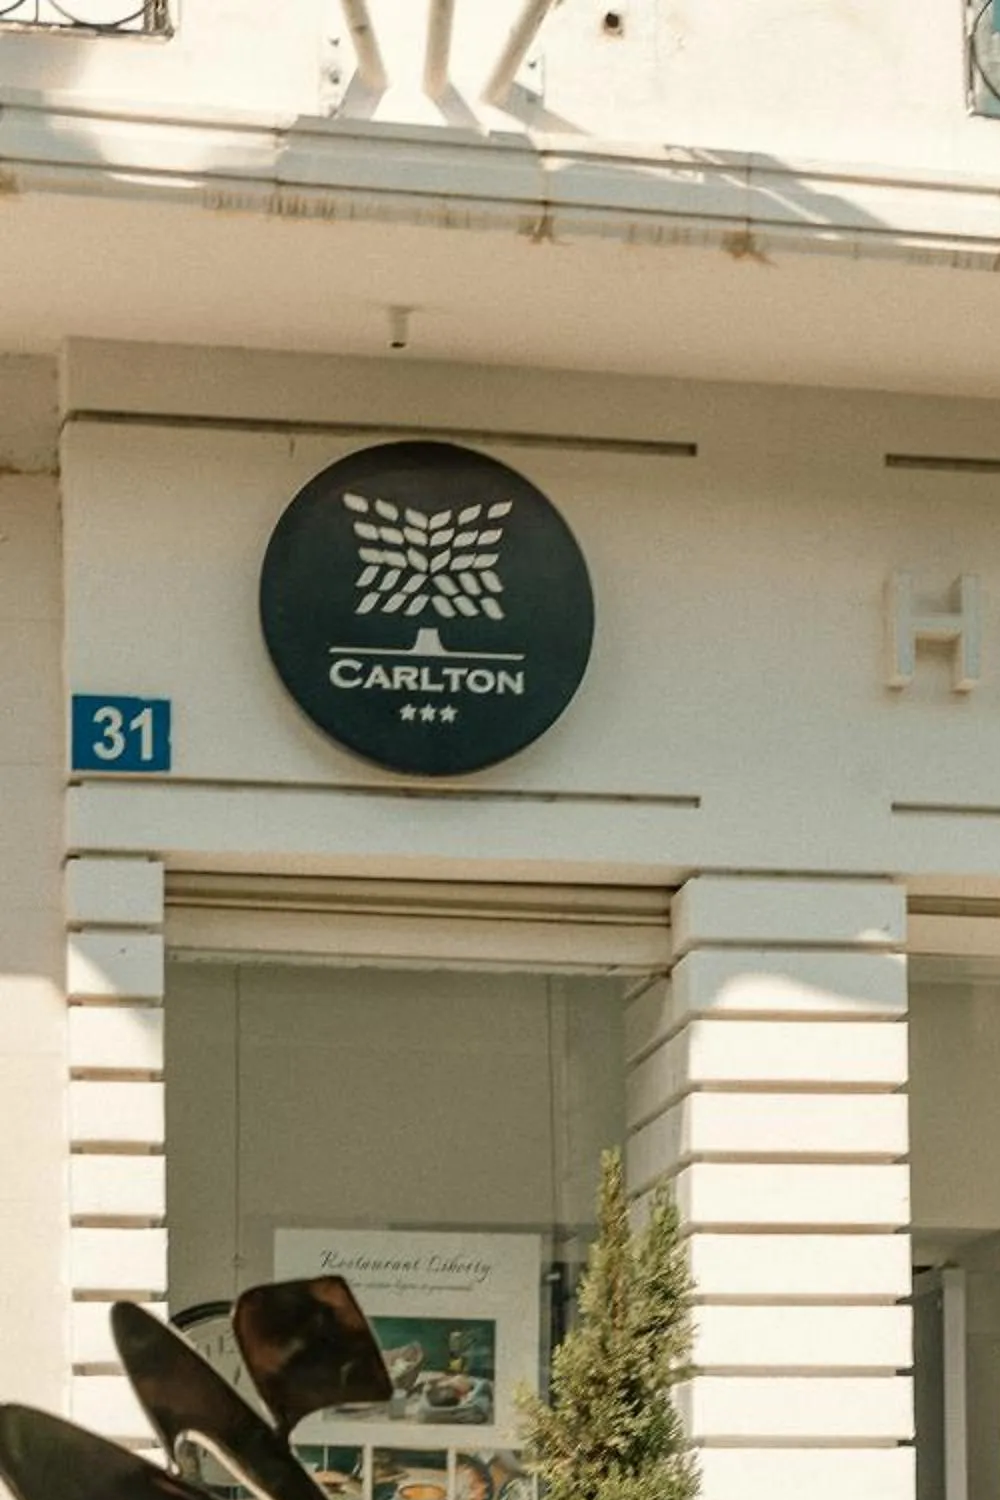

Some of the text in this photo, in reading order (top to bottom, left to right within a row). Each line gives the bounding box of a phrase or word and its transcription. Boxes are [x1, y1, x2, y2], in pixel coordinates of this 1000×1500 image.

[329, 659, 525, 695] CARLTON
[92, 706, 154, 761] 31
[319, 1250, 420, 1271] Restaurant
